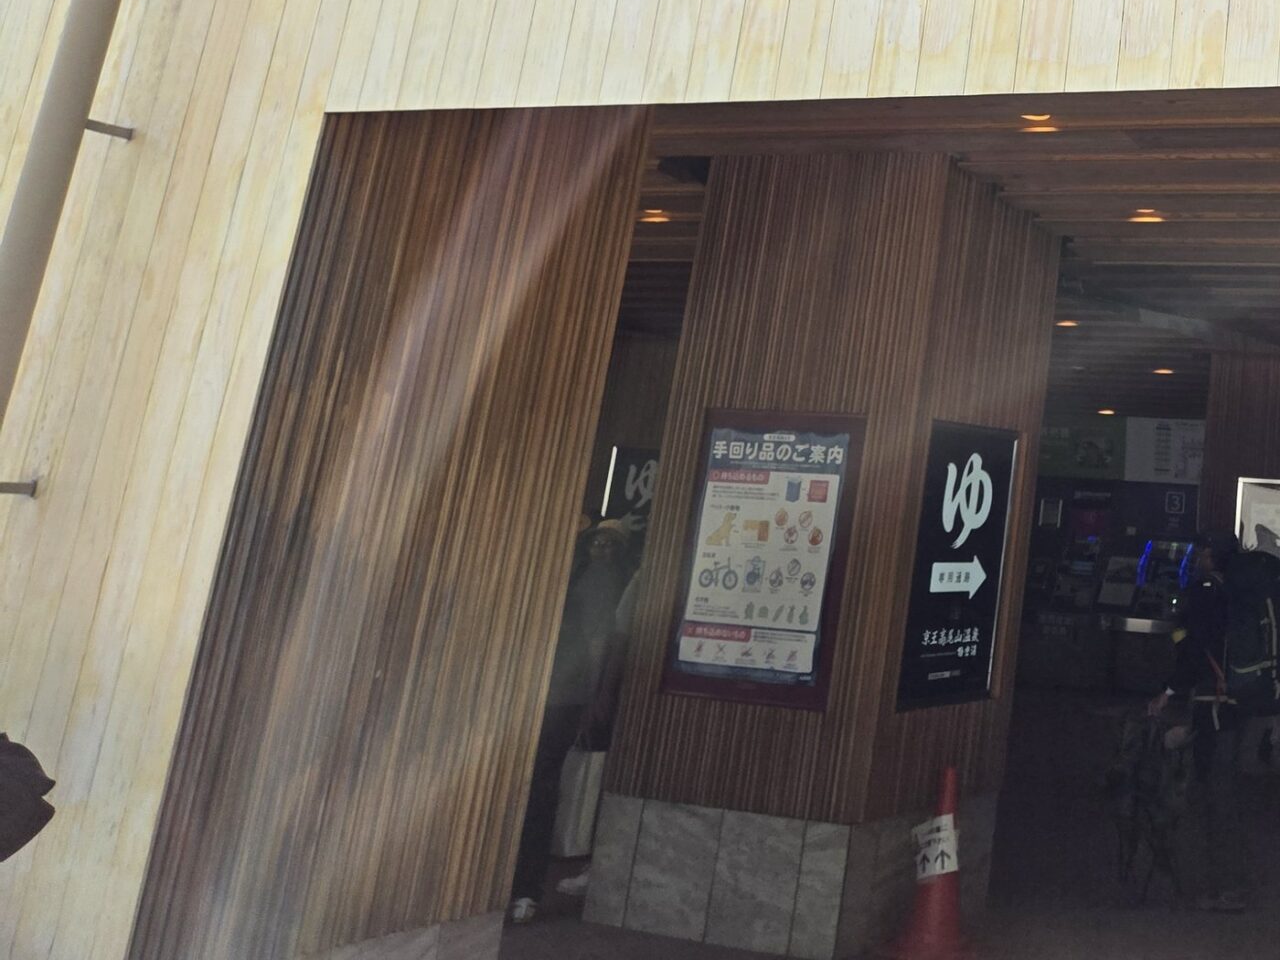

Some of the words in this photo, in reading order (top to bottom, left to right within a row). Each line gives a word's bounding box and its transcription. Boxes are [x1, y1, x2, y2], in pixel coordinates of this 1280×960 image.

[713, 441, 844, 464] 手回り品のご案内
[942, 452, 992, 549] ゆ
